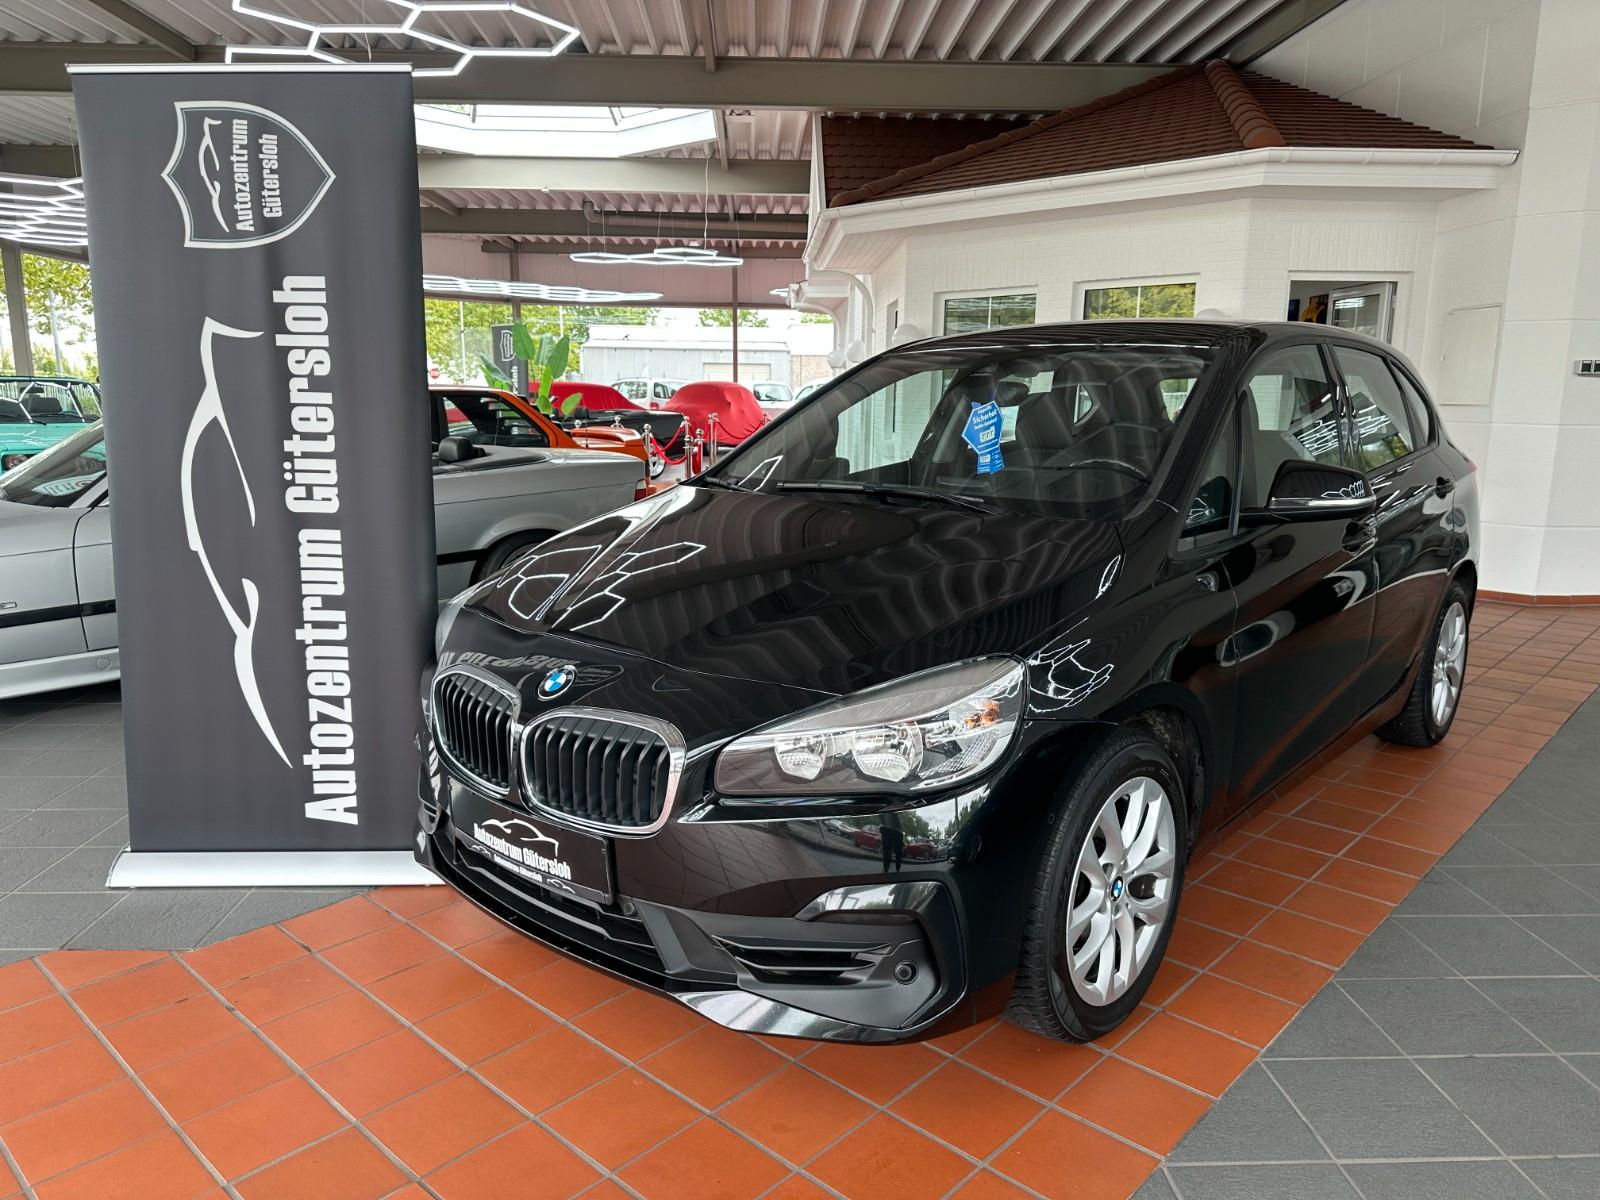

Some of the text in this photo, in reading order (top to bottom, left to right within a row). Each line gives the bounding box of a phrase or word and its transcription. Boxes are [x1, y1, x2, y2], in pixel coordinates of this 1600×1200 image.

[230, 119, 255, 231] Autozentrum
[258, 134, 282, 217] Gütersloh
[272, 275, 359, 825] Autozentrum Gütersloh
[473, 822, 523, 862] Autozentrum
[523, 847, 572, 880] Gütersloh
